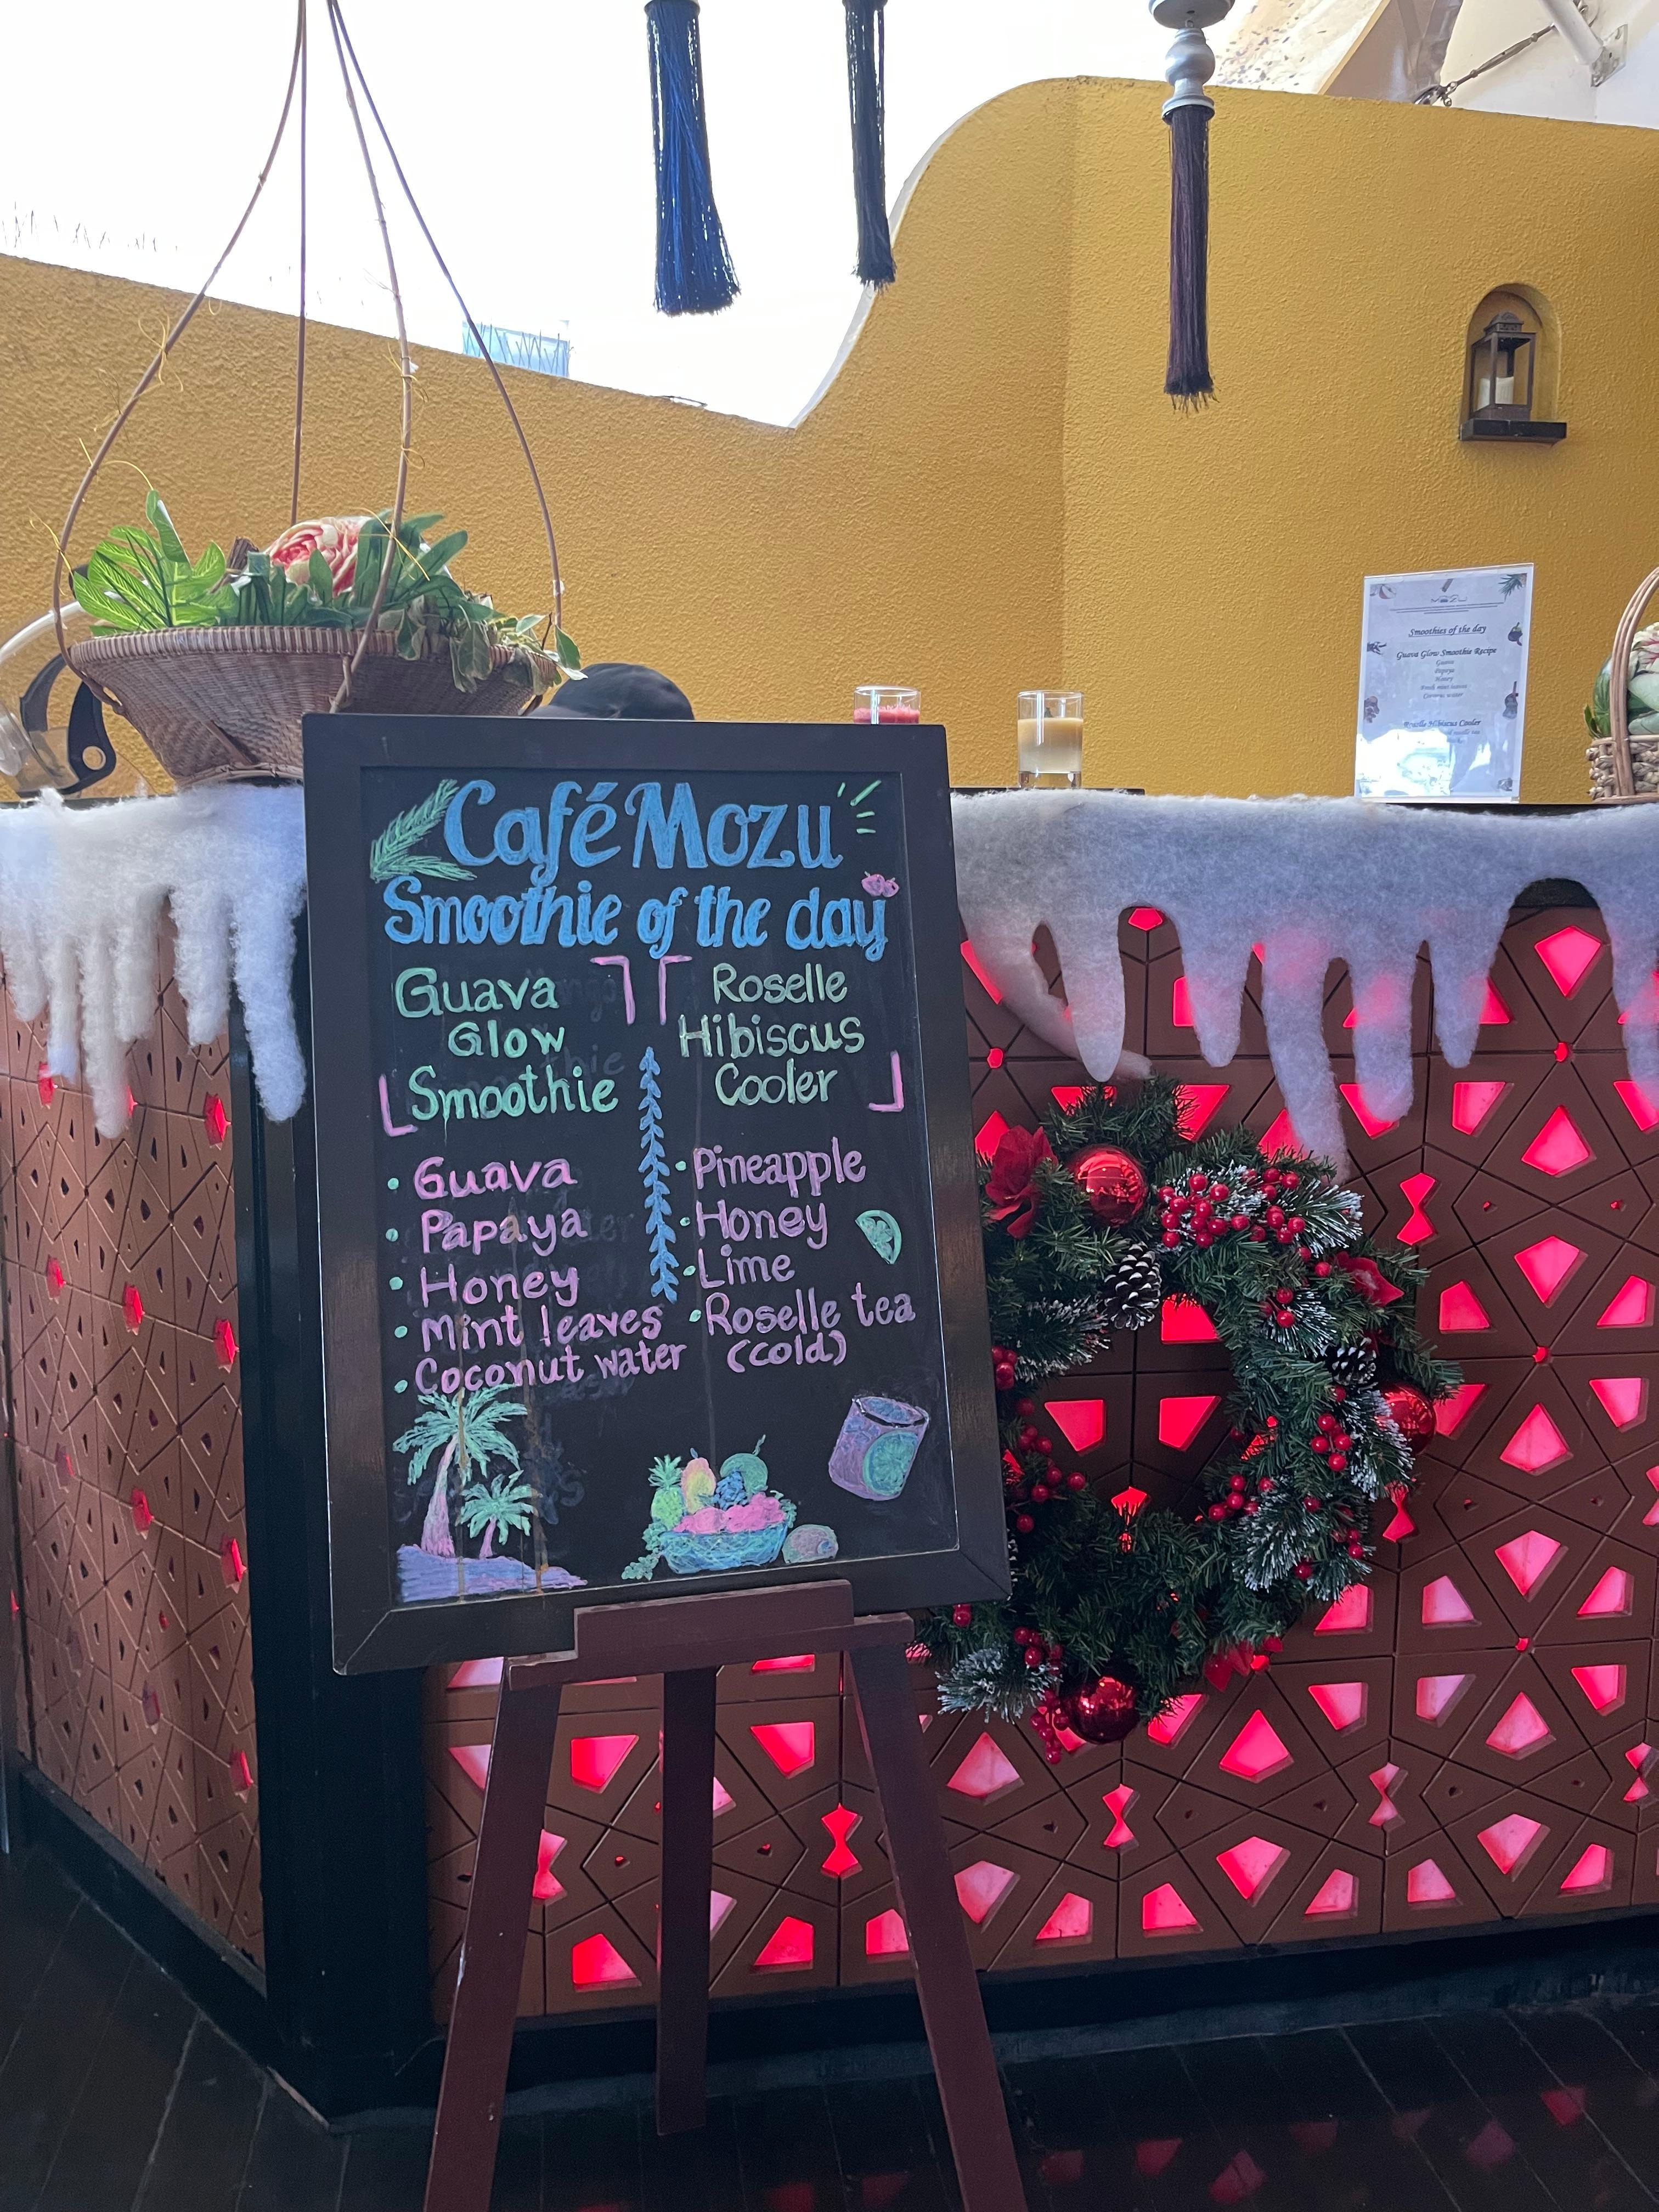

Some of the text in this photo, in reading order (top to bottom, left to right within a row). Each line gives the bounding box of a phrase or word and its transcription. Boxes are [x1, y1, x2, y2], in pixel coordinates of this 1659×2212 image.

[1409, 623, 1487, 637] Smoothies of the day
[1396, 647, 1497, 661] Guava Glow Smoothie Recipe
[1459, 718, 1481, 727] Cooler
[444, 779, 844, 887] Café Mozu
[383, 876, 889, 962] Smoothie of the day
[395, 967, 560, 1018] Guava
[713, 962, 848, 1005] Roselle
[448, 1019, 565, 1058] Glow
[678, 1012, 865, 1058] Hibiscus
[408, 1064, 619, 1121] Smoothie
[715, 1058, 838, 1107] Cooler
[414, 1156, 578, 1200] Guava
[693, 1136, 867, 1198] Pineapple
[421, 1208, 588, 1257] Papaya
[696, 1199, 828, 1250] Honey
[420, 1263, 580, 1308] Honey
[698, 1243, 795, 1289] Lime
[540, 1304, 664, 1347] leaves
[706, 1282, 916, 1336] Roselle tea
[415, 1339, 688, 1395] Coconut water
[727, 1329, 847, 1373] (cold)
